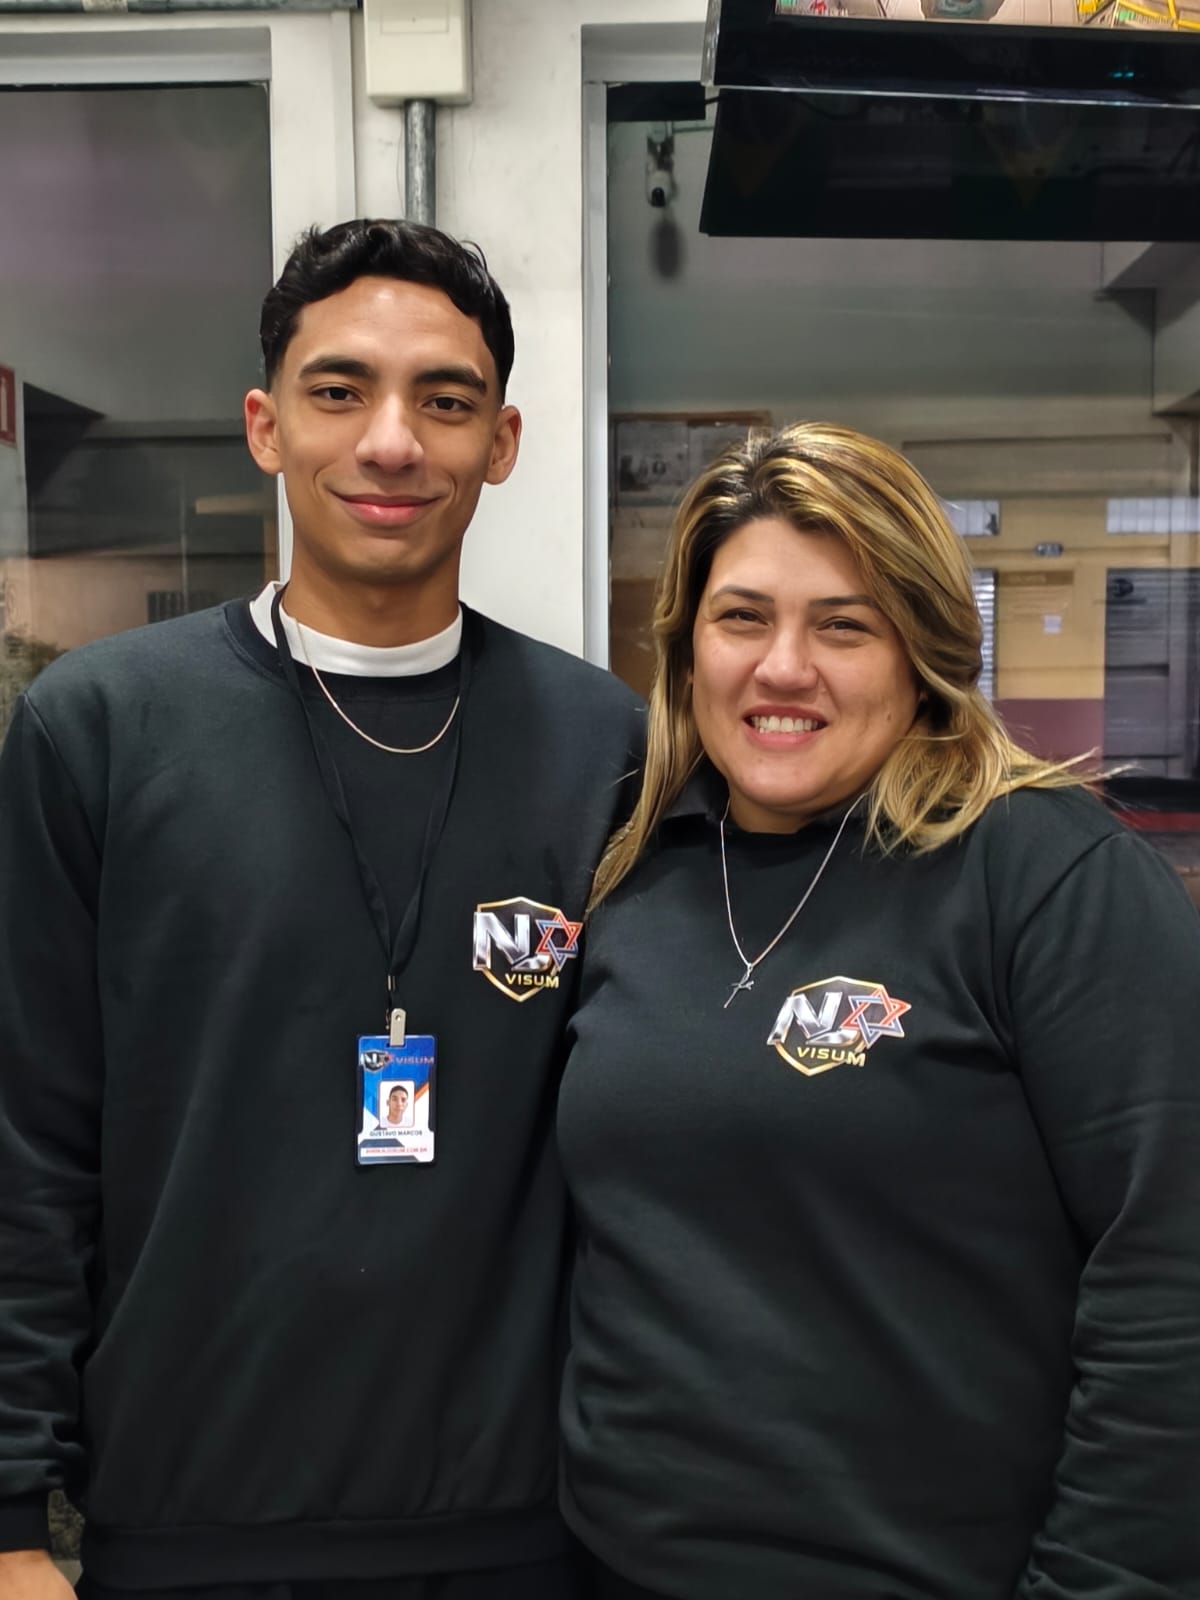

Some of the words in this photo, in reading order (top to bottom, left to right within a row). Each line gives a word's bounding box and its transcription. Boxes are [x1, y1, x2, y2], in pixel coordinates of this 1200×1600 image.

[505, 973, 560, 989] VISUM
[395, 1056, 435, 1065] VISUM
[797, 1047, 866, 1067] VISUM
[369, 1129, 397, 1137] GUSTAVO
